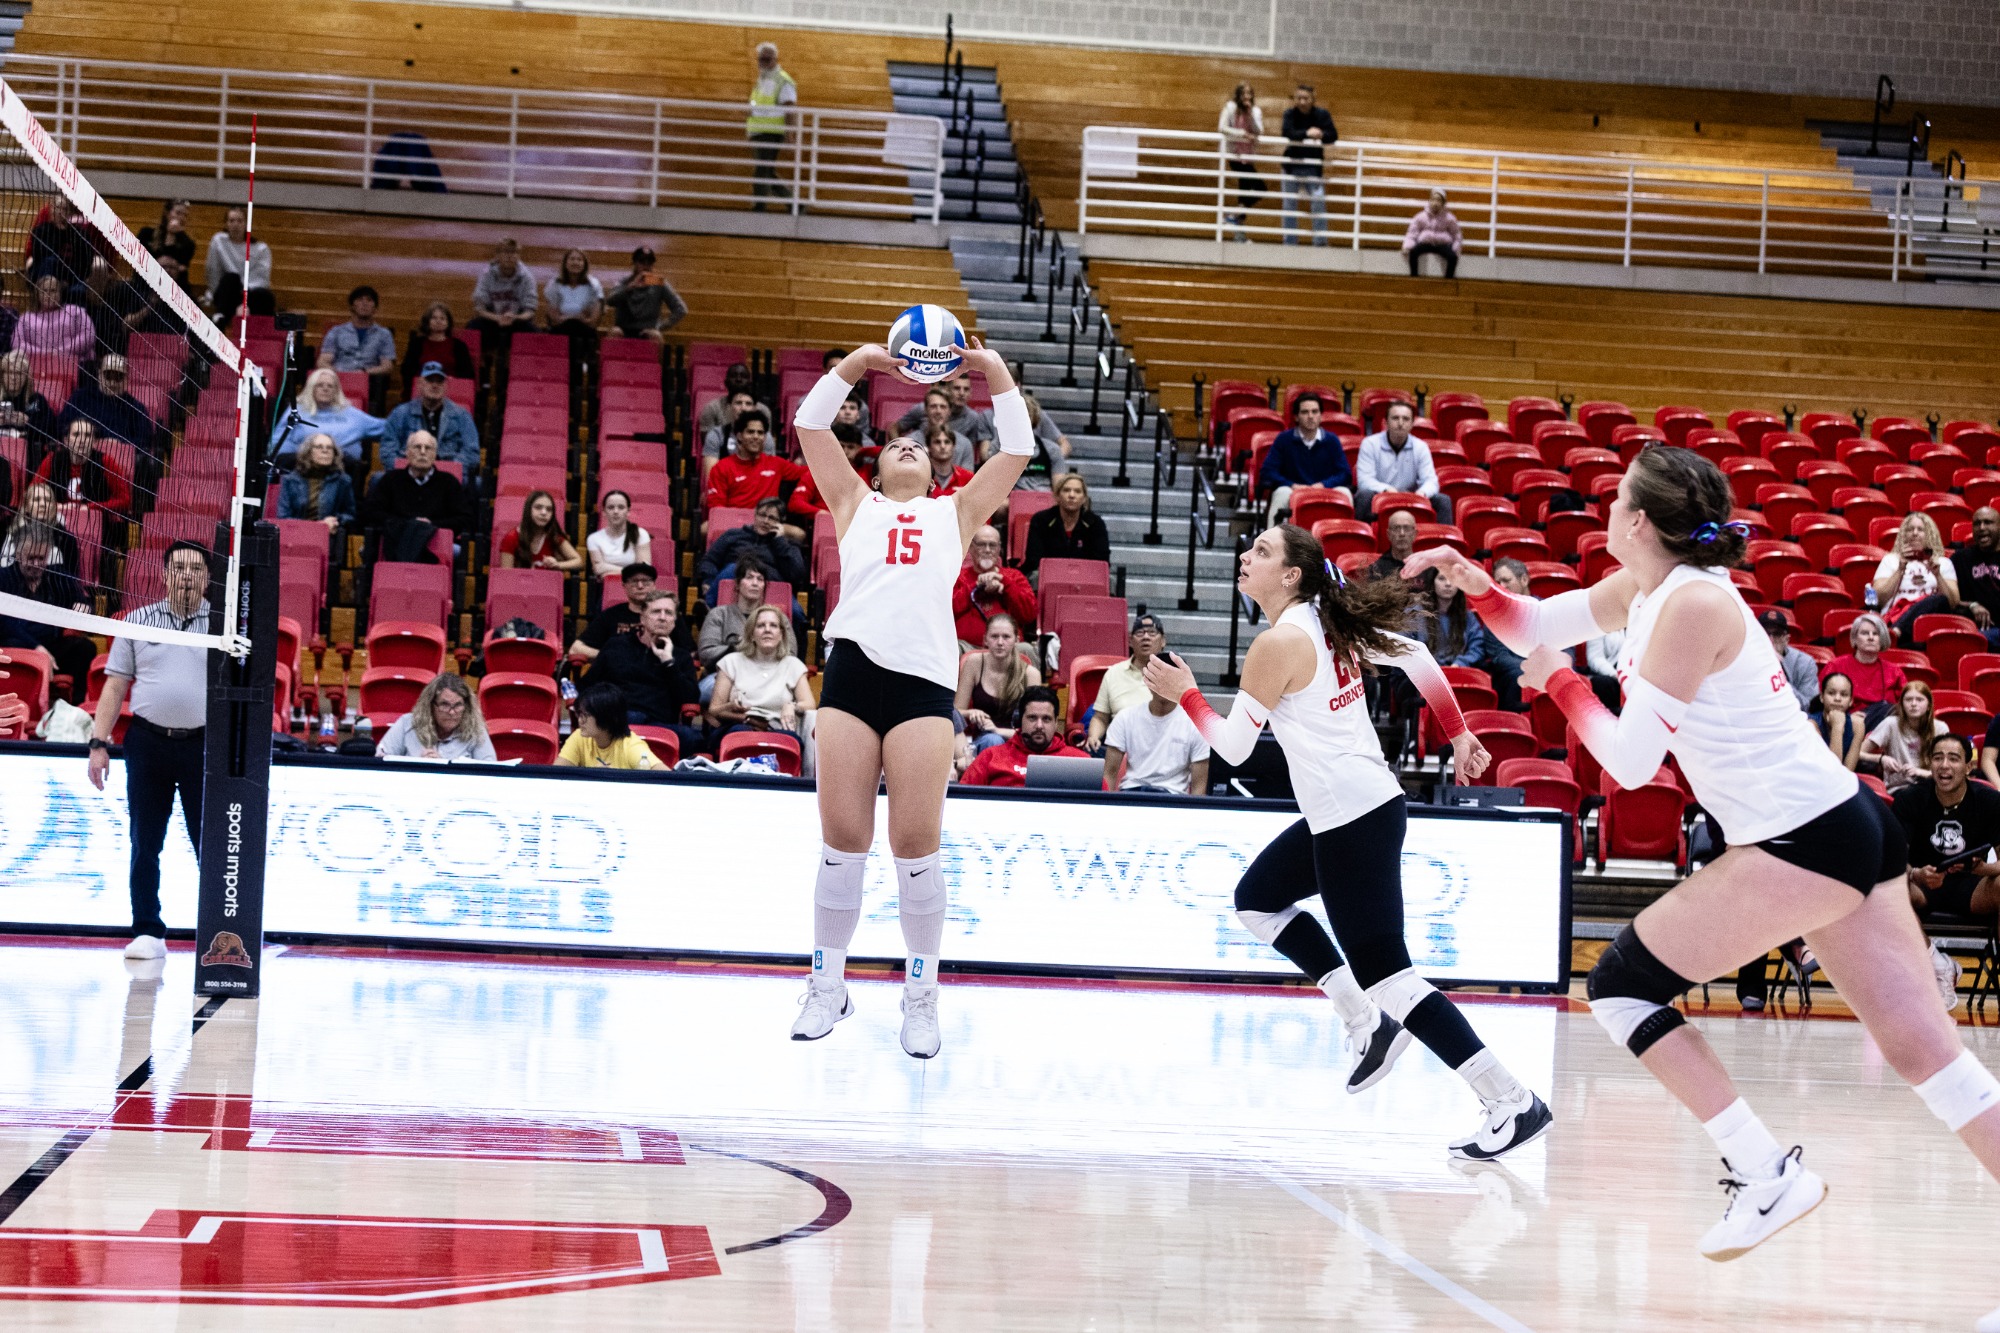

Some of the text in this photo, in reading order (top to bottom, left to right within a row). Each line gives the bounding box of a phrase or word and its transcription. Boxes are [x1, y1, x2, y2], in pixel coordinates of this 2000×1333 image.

[910, 348, 952, 359] molten
[911, 361, 947, 374] NCAA
[885, 528, 923, 565] 15
[223, 802, 242, 918] sports imports
